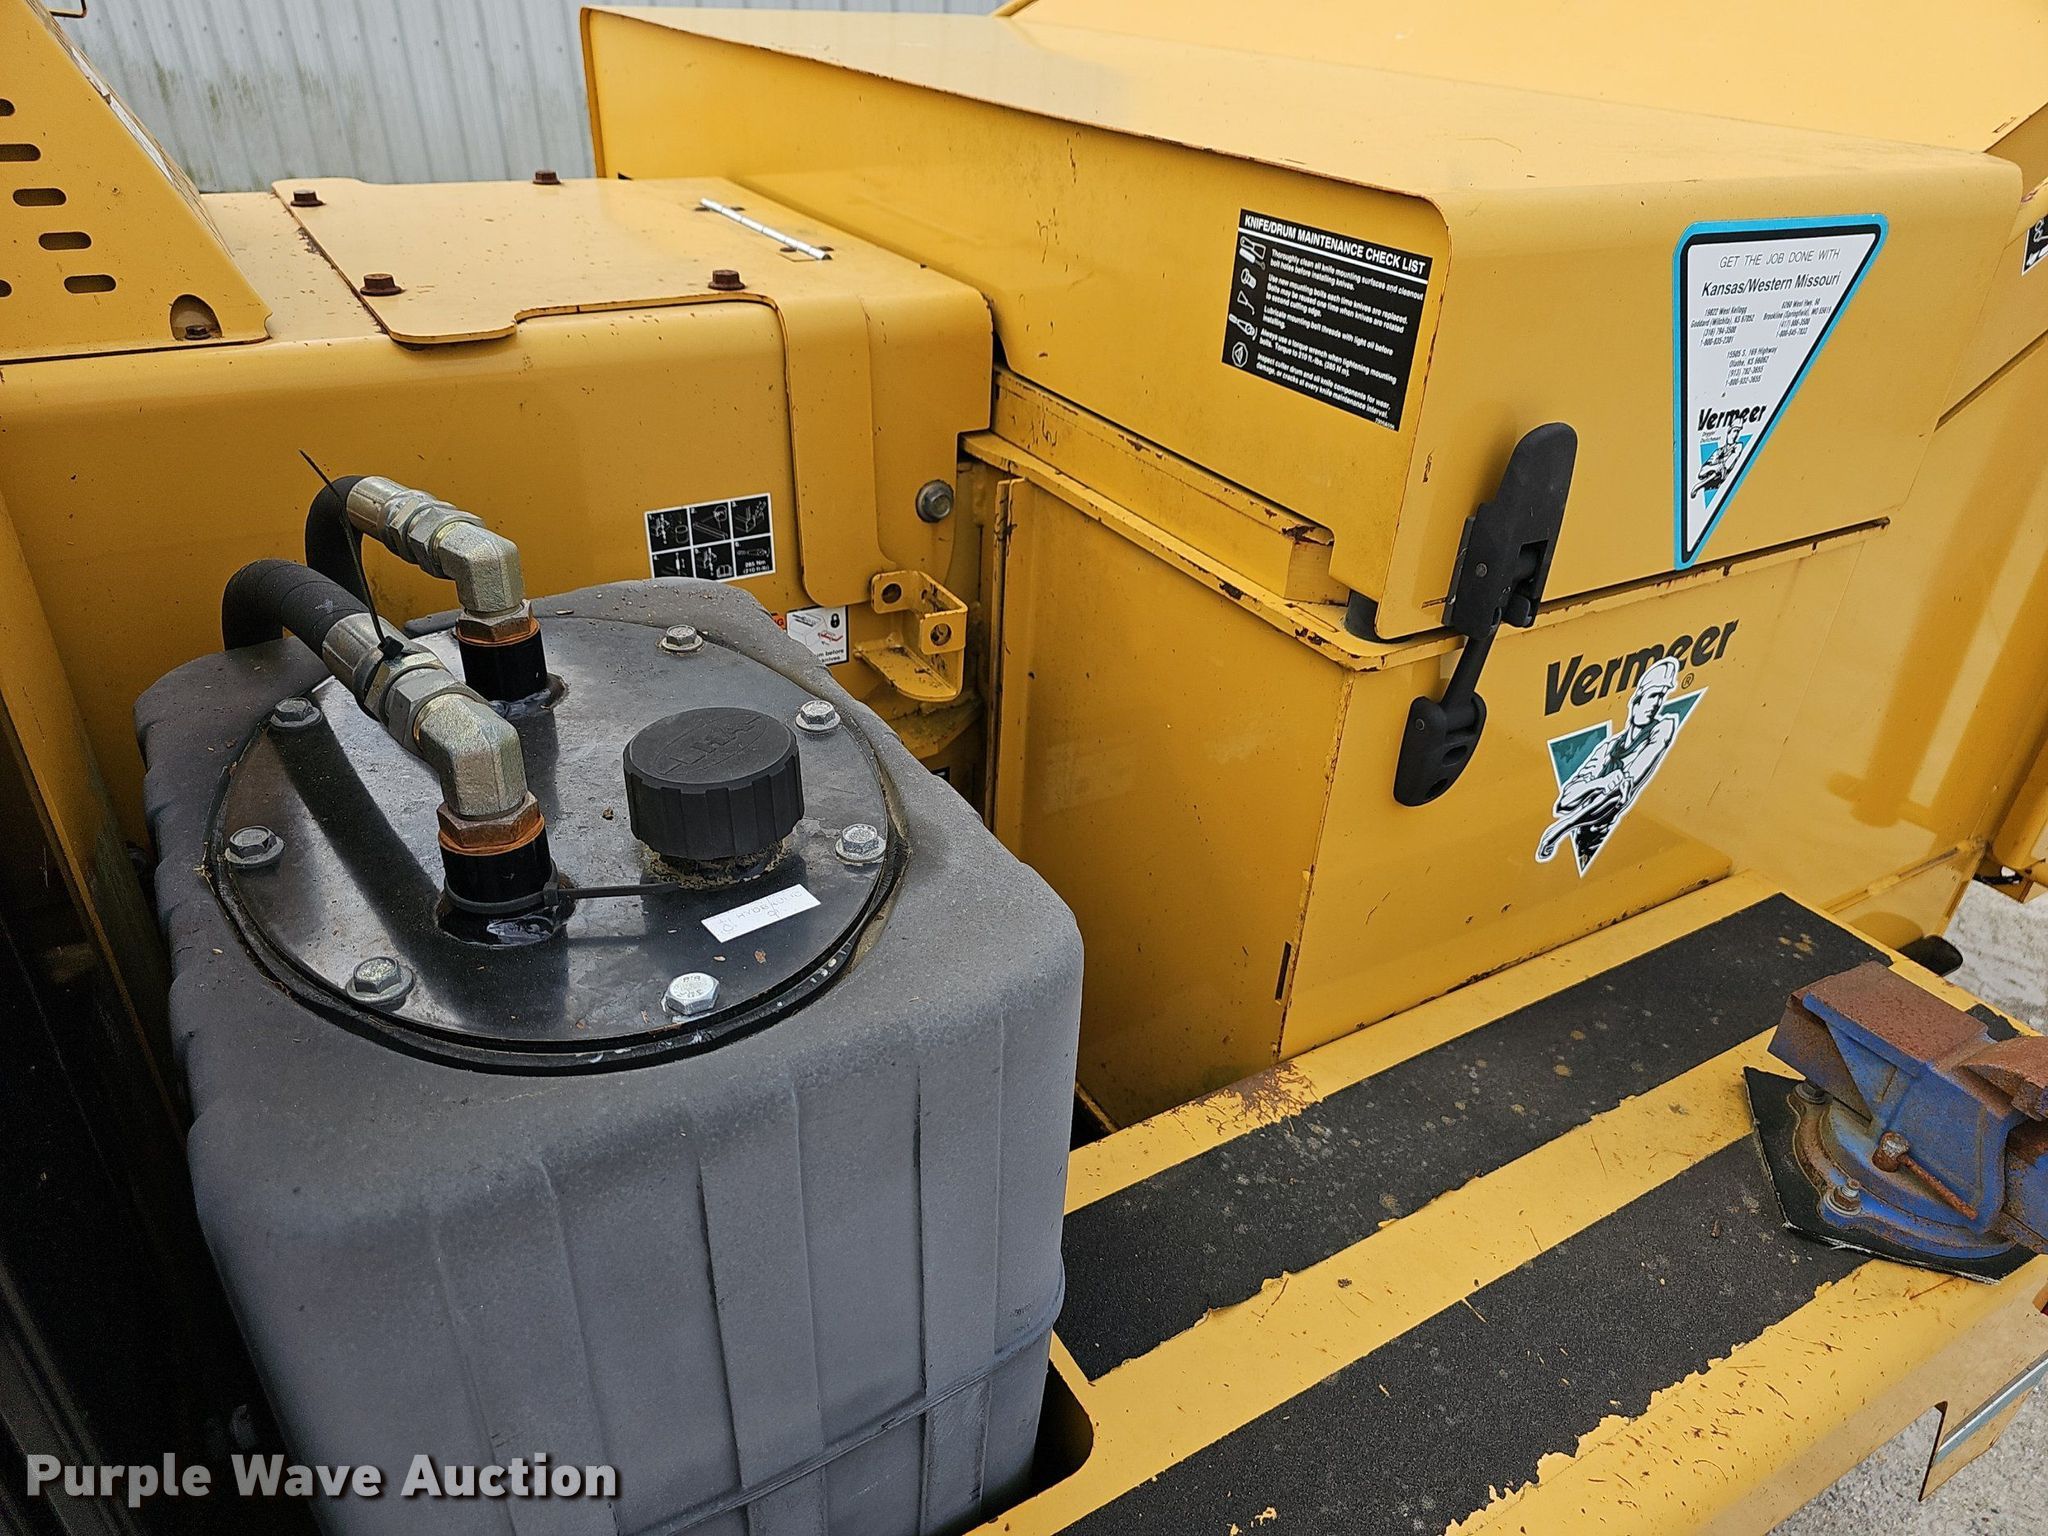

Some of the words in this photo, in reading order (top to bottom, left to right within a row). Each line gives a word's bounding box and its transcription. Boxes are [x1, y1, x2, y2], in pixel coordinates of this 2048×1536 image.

[1244, 214, 1296, 240] KNIFE/DRUM
[1298, 229, 1364, 258] MAINTENANCE
[1366, 248, 1400, 268] CHECK
[1402, 259, 1426, 275] LIST
[1720, 256, 1740, 268] GET
[1744, 254, 1762, 266] THE
[1766, 252, 1784, 265] JOB
[1788, 250, 1814, 263] DONE
[1818, 248, 1840, 260] WITH
[1271, 259, 1280, 268] bolt
[1281, 262, 1294, 272] holes
[1295, 266, 1311, 277] before
[1312, 271, 1335, 286] installing
[1272, 250, 1299, 265] Thoroughly
[1300, 258, 1314, 268] clean
[1322, 264, 1334, 274] knife
[1336, 268, 1361, 283] mounting
[1386, 282, 1398, 292] and
[1701, 278, 1792, 297] Kansas/Western
[1794, 271, 1842, 288] Missouri
[1267, 284, 1279, 293] Bolts
[1281, 288, 1291, 298] may
[1299, 294, 1316, 305] reused
[1317, 299, 1327, 308] one
[1328, 303, 1339, 312] time
[1340, 306, 1354, 317] when
[1355, 311, 1373, 323] knives
[1374, 317, 1383, 326] are
[1384, 320, 1404, 332] rotated
[1268, 275, 1278, 283] Use
[1279, 278, 1289, 287] new
[1290, 281, 1313, 295] mounting
[1328, 293, 1340, 303] each
[1341, 297, 1353, 306] time
[1354, 300, 1371, 312] knives
[1372, 306, 1381, 315] are
[1272, 295, 1289, 306] second
[1290, 301, 1307, 314] cutting
[1731, 306, 1748, 314] Kellogg
[1264, 306, 1286, 319] Lubricate
[1287, 313, 1310, 329] mounting
[1311, 321, 1321, 331] bolt
[1322, 325, 1341, 338] threads
[1342, 332, 1354, 342] with
[1354, 336, 1366, 348] light
[1375, 343, 1393, 355] before
[1261, 328, 1278, 342] Always
[1279, 335, 1287, 344] use
[1292, 340, 1308, 352] torque
[1309, 345, 1327, 358] wrench
[1328, 352, 1342, 363] when
[1342, 357, 1370, 375] tightening
[1370, 367, 1397, 385] mounting
[1275, 343, 1292, 356] Torque
[1758, 346, 1778, 356] Highway
[1258, 353, 1275, 366] Inspect
[1276, 360, 1289, 371] cutter
[1290, 366, 1303, 376] drum
[1304, 371, 1313, 380] and
[1321, 377, 1333, 387] knife
[1334, 382, 1366, 401] components
[1283, 372, 1298, 384] cracks
[1305, 381, 1318, 393] every
[1320, 386, 1332, 396] knife
[1333, 391, 1366, 409] maintenance
[1698, 405, 1767, 431] Vermeer
[1544, 619, 1740, 716] Vermeer
